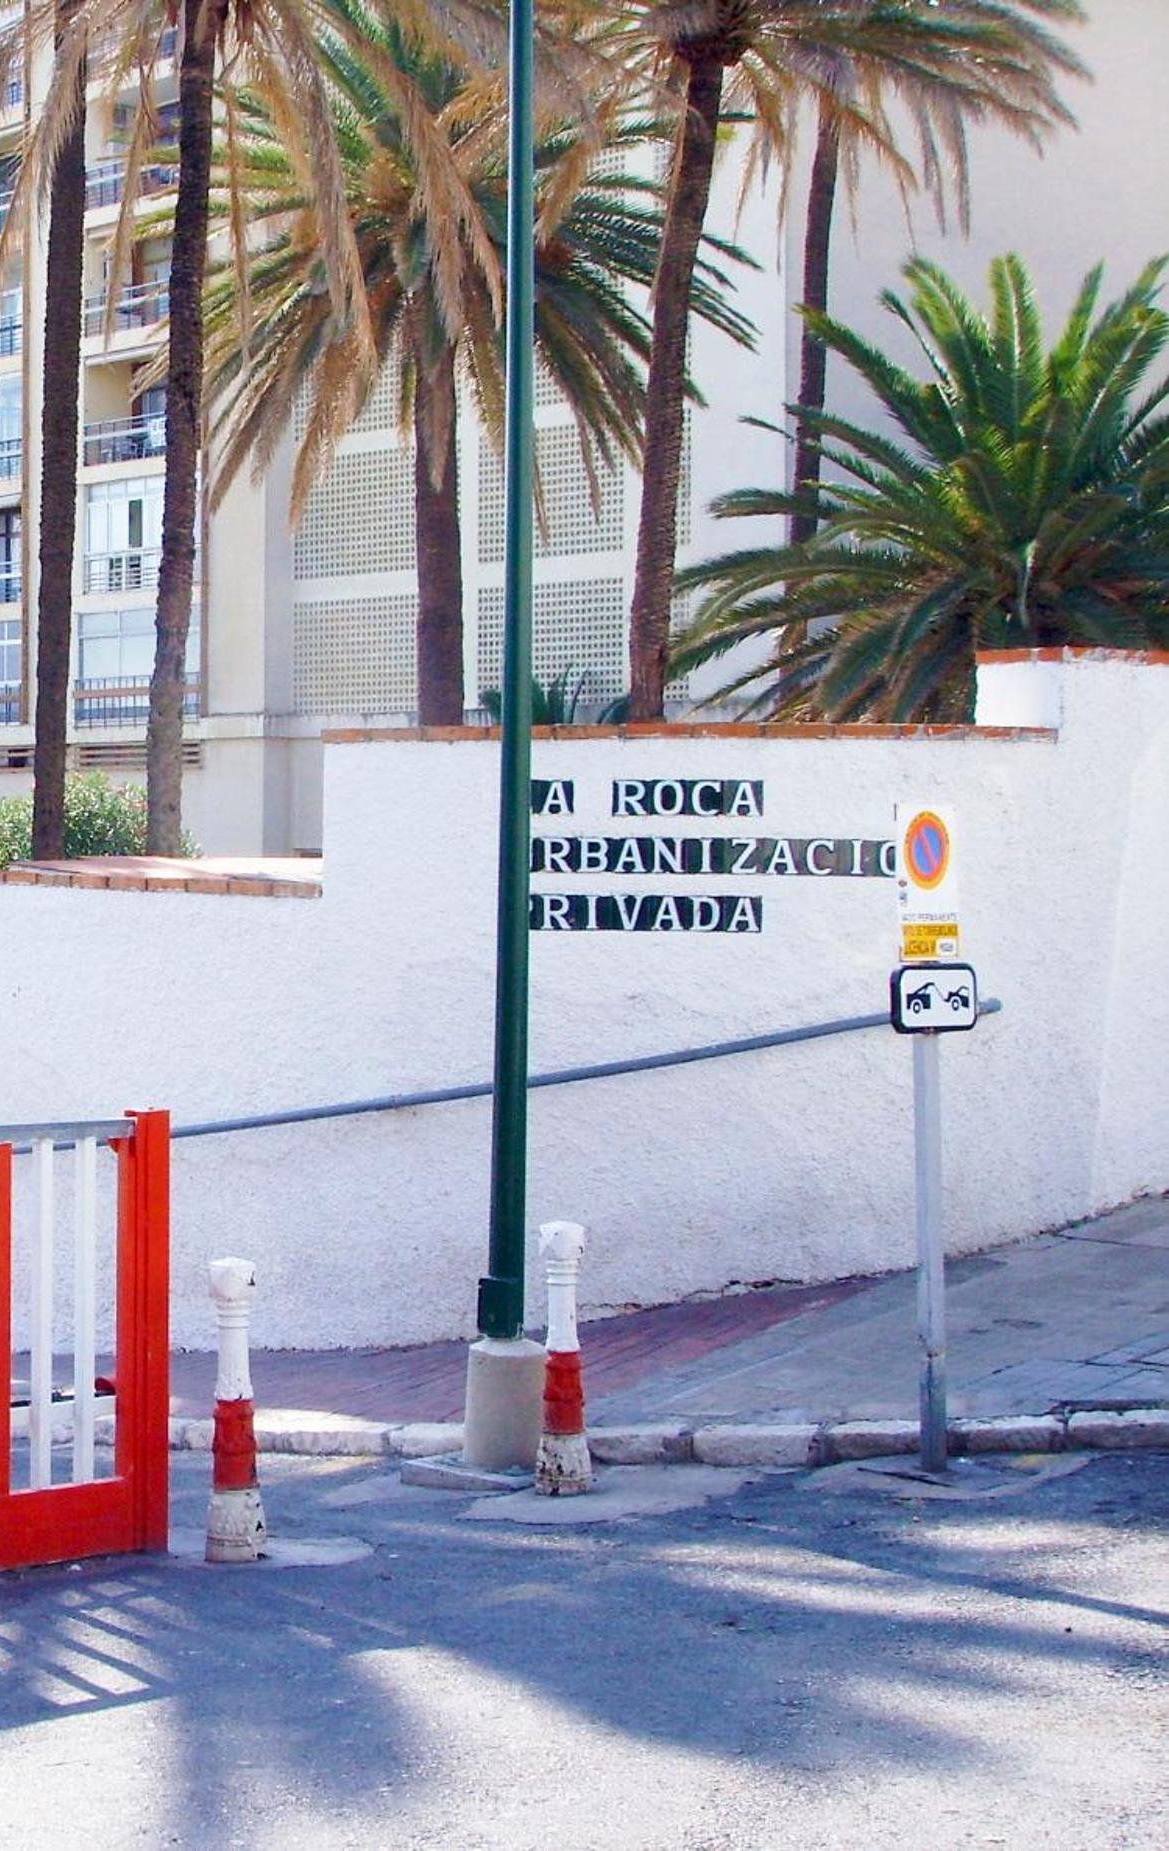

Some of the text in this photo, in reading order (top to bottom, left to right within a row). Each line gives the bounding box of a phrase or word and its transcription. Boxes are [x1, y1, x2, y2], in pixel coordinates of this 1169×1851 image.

[530, 780, 762, 816] A ROCA
[530, 837, 896, 876] RBANIZACIO
[529, 895, 761, 932] RIVADA
